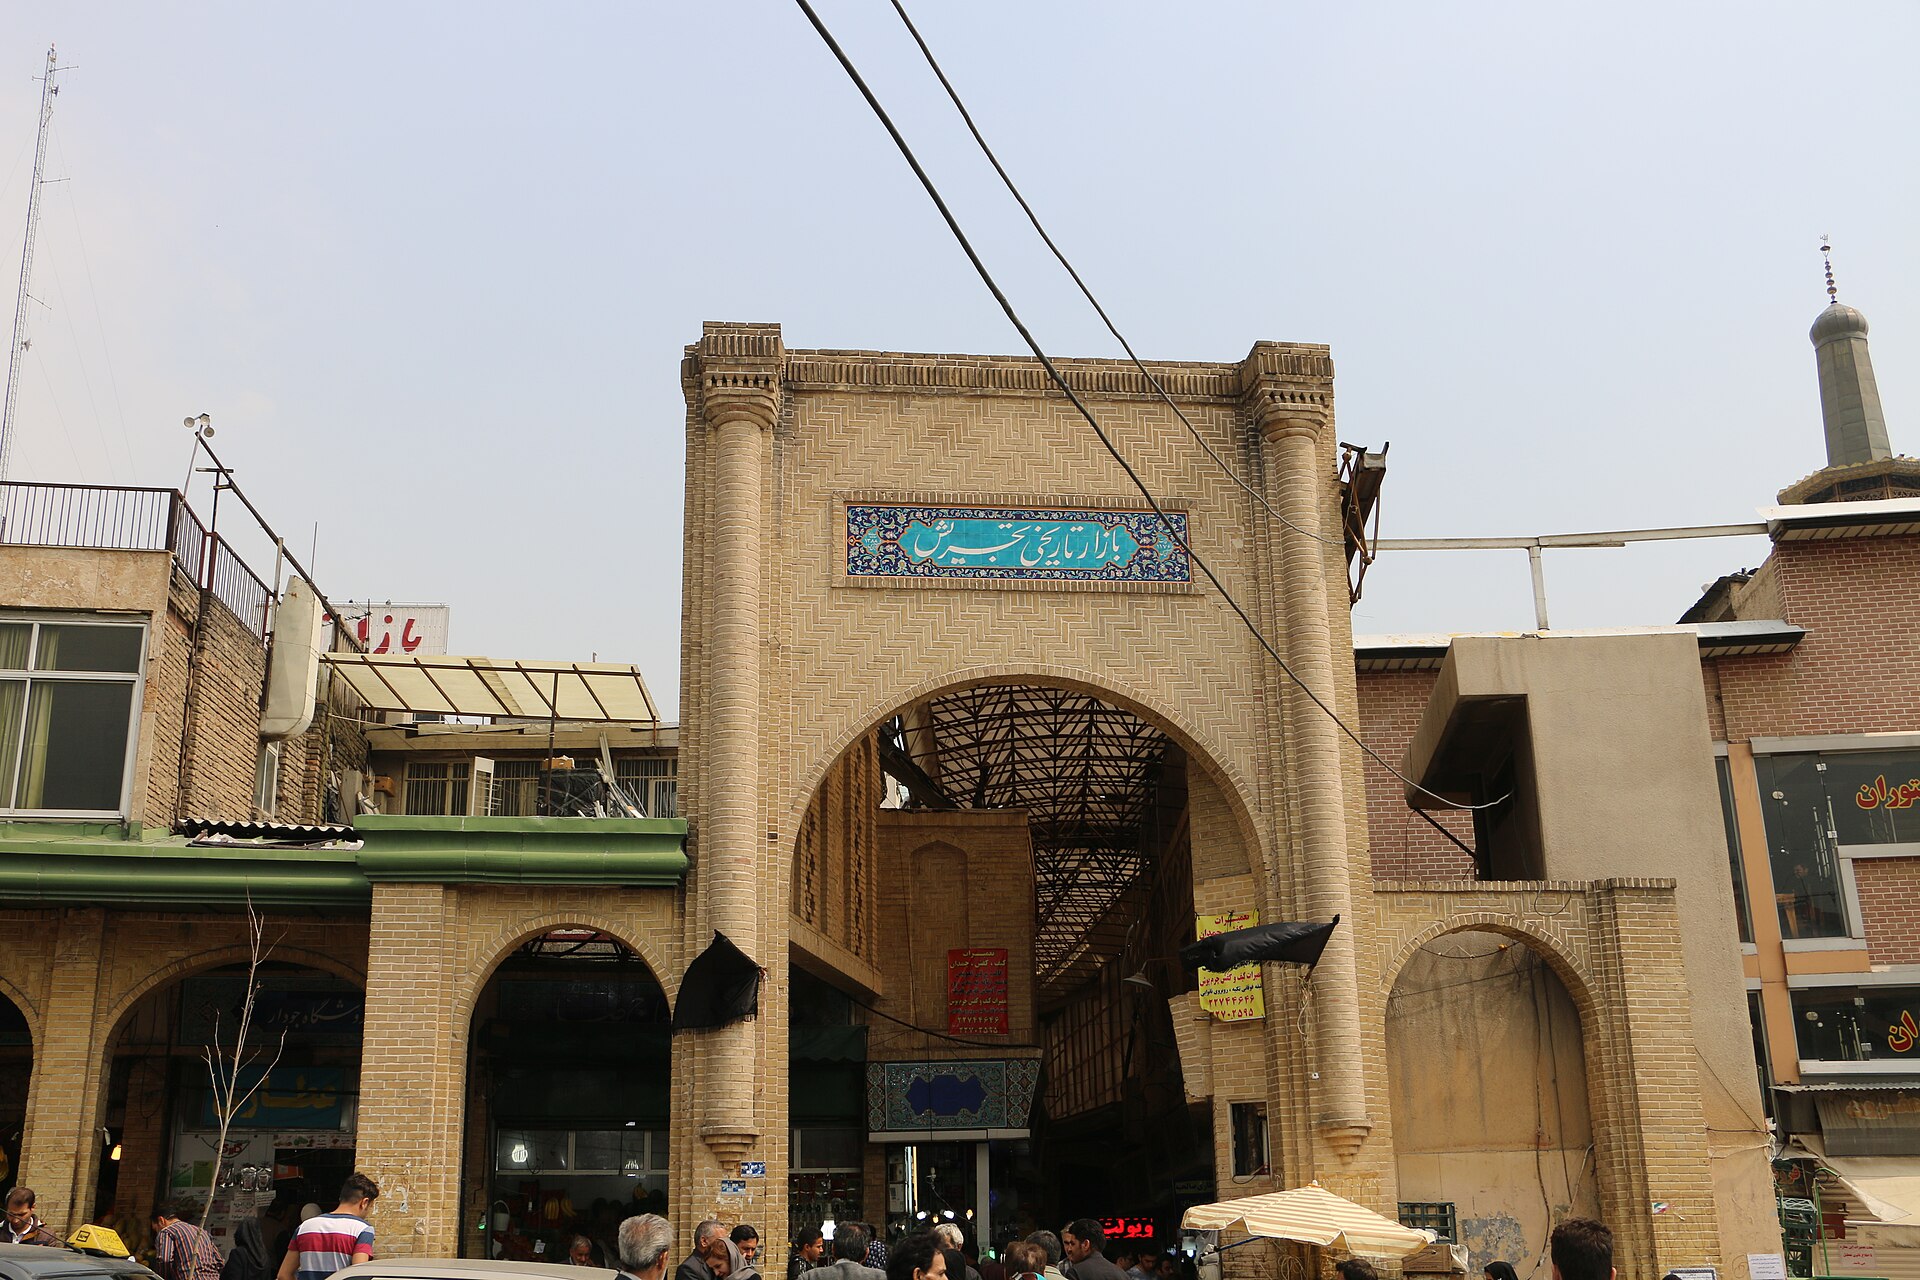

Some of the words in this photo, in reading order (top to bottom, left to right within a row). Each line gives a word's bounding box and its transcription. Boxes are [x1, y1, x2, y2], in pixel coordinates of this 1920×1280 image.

[914, 519, 1032, 565] تجریش
[1020, 525, 1084, 566] تاریخی
[1076, 529, 1120, 561] بازار
[1856, 774, 1920, 809] توران
